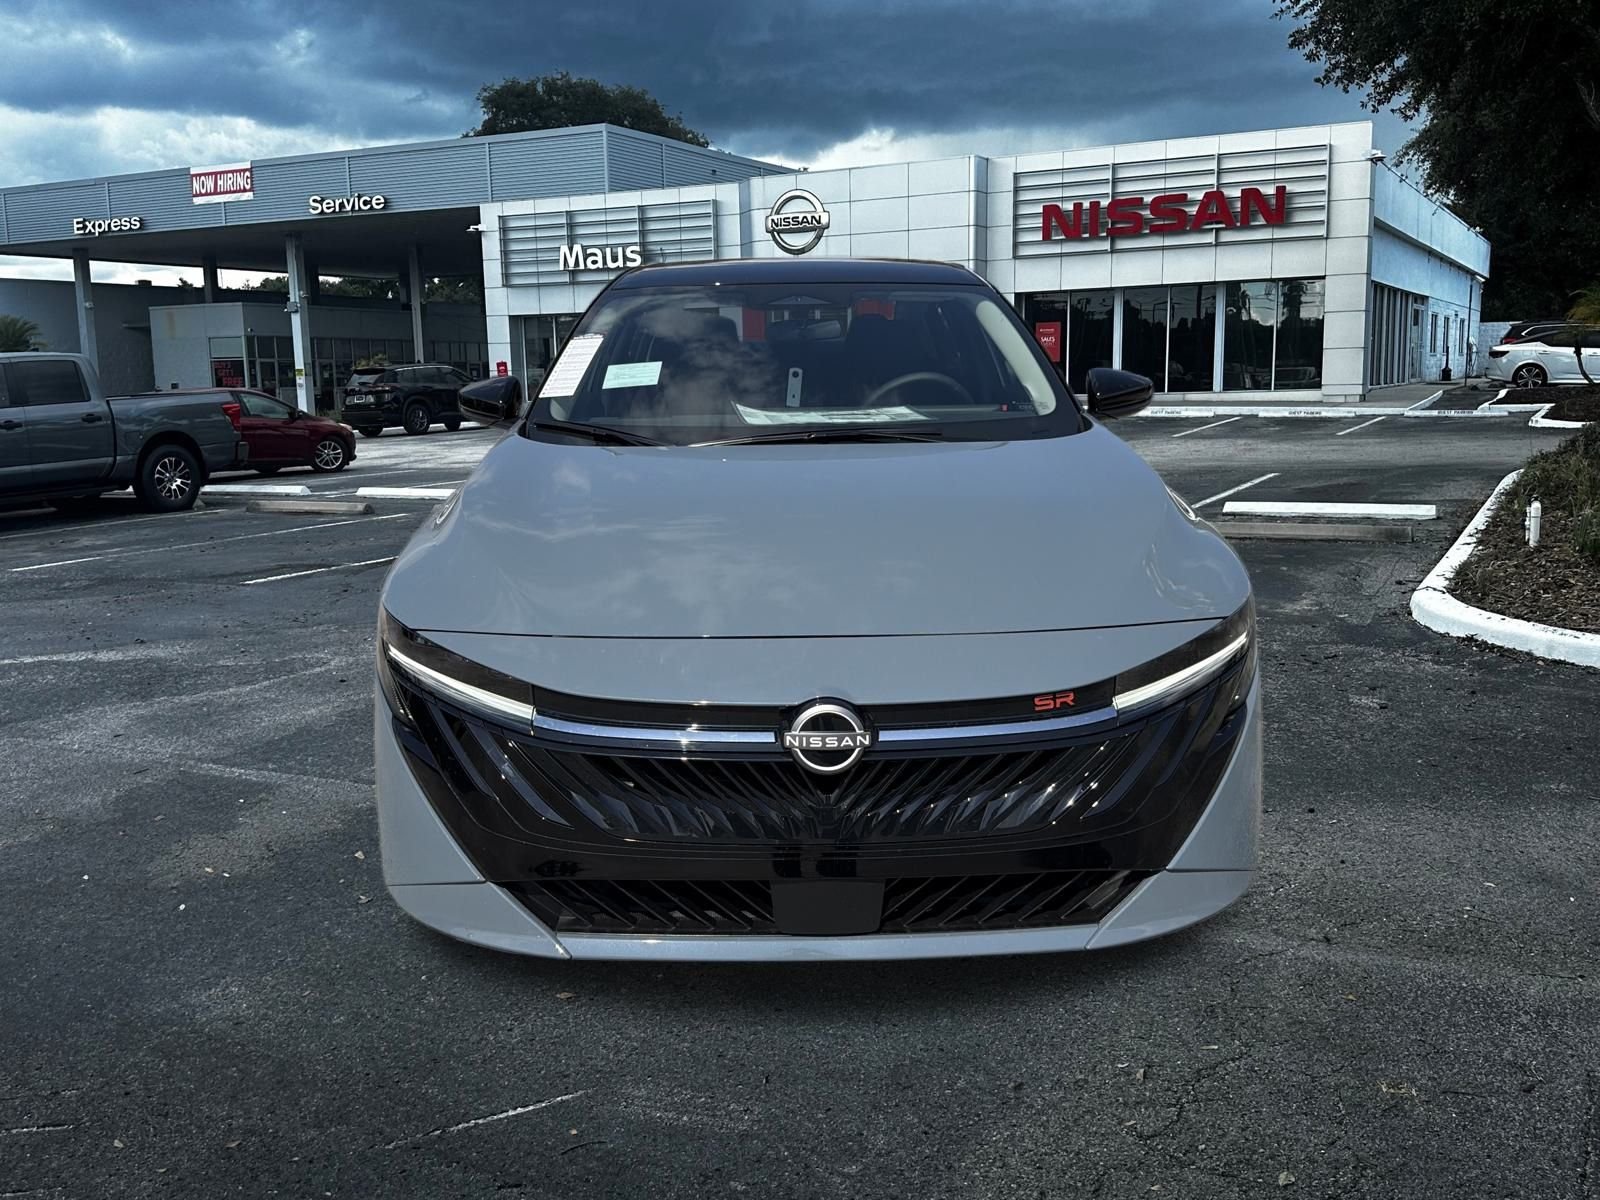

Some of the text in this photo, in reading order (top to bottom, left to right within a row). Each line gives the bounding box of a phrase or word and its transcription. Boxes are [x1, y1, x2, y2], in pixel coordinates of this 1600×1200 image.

[192, 171, 251, 195] NOW HIRING
[308, 193, 385, 215] Service
[1042, 185, 1287, 241] NISSAN
[73, 216, 141, 237] Express
[770, 215, 822, 228] NISSAN
[559, 243, 642, 271] Maus
[1034, 691, 1075, 711] SR
[785, 735, 870, 748] NISSAN
